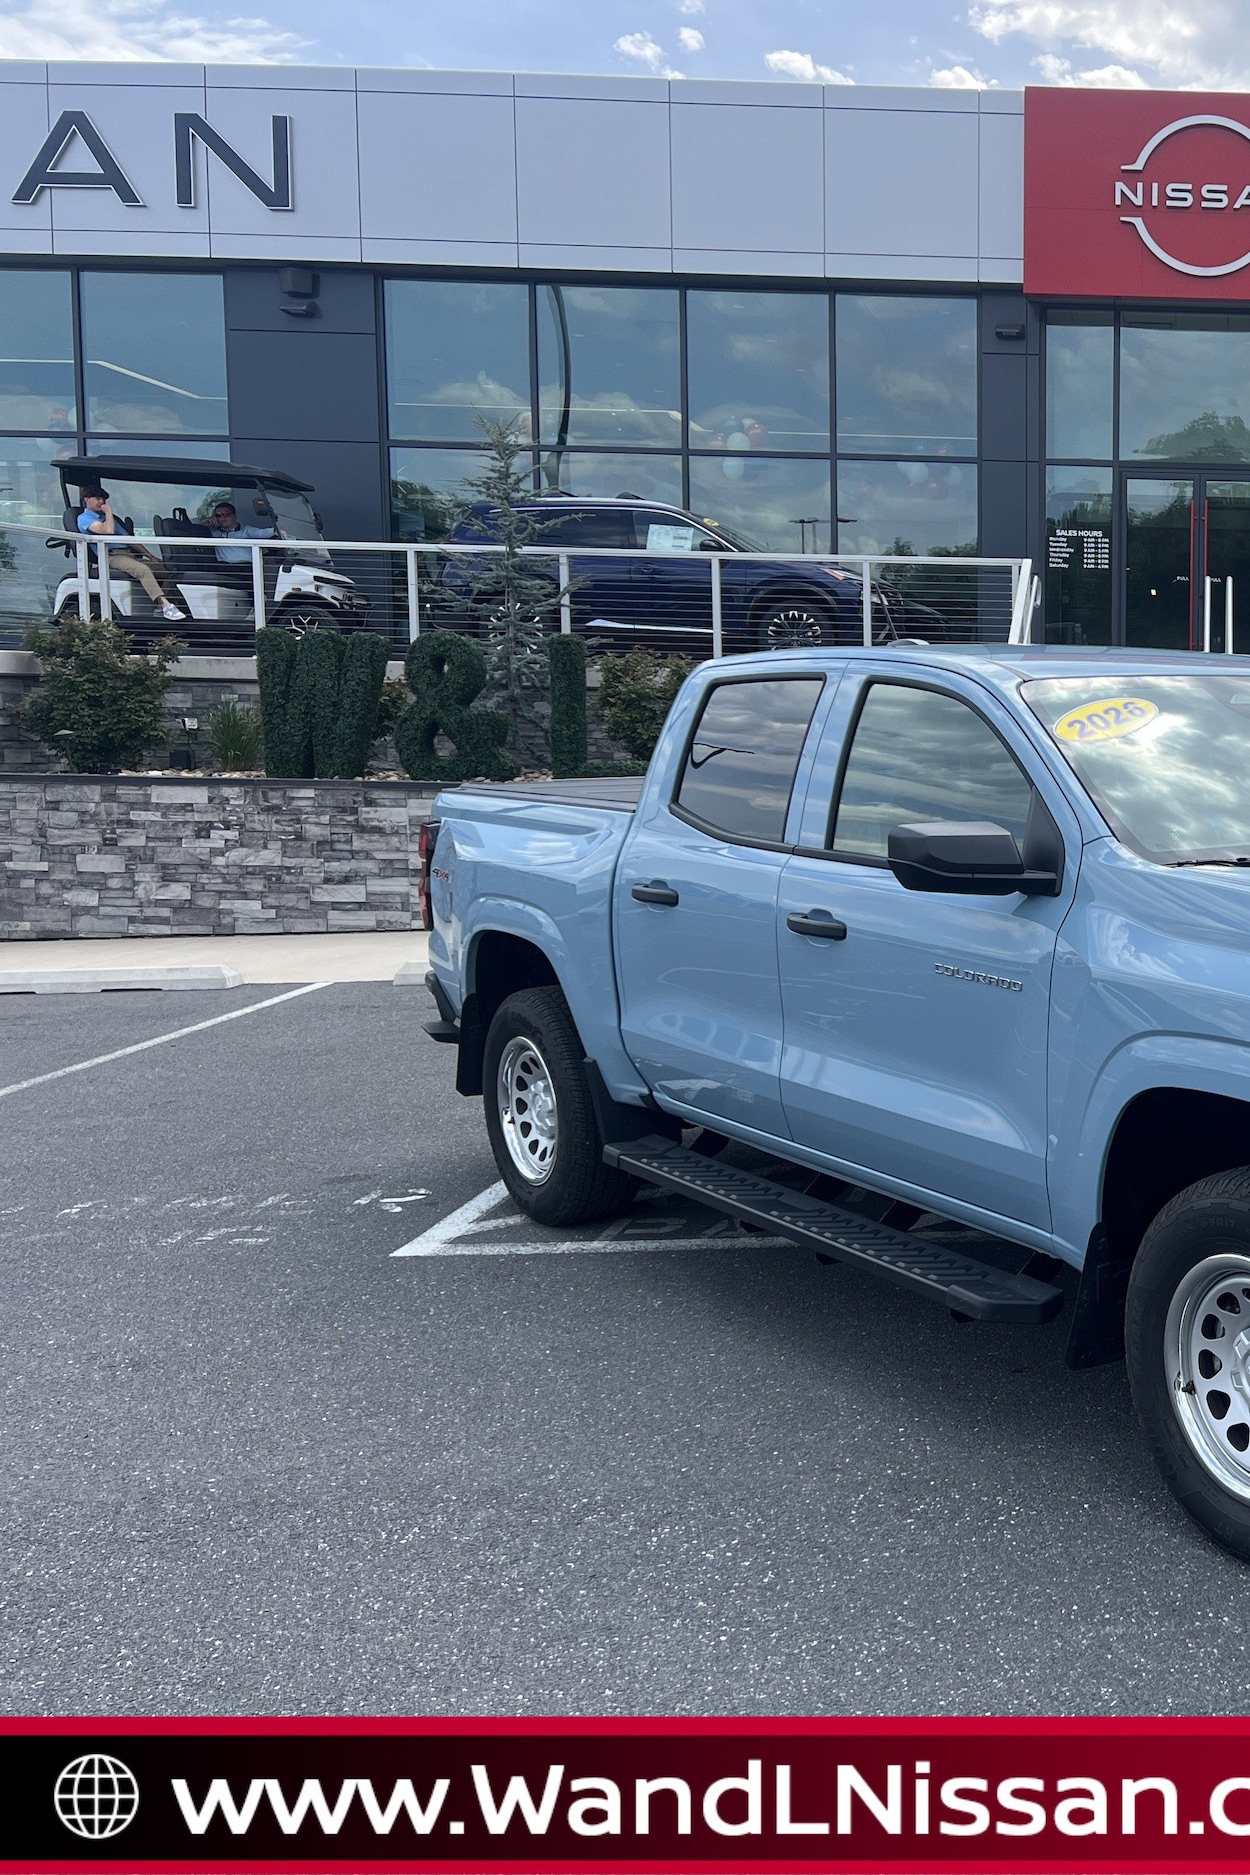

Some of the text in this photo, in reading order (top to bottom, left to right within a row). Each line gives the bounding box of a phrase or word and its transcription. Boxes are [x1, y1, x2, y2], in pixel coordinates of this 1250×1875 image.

[10, 109, 293, 211] AN
[255, 626, 393, 779] W
[1067, 702, 1146, 739] 2026
[934, 962, 1023, 991] COLORADO
